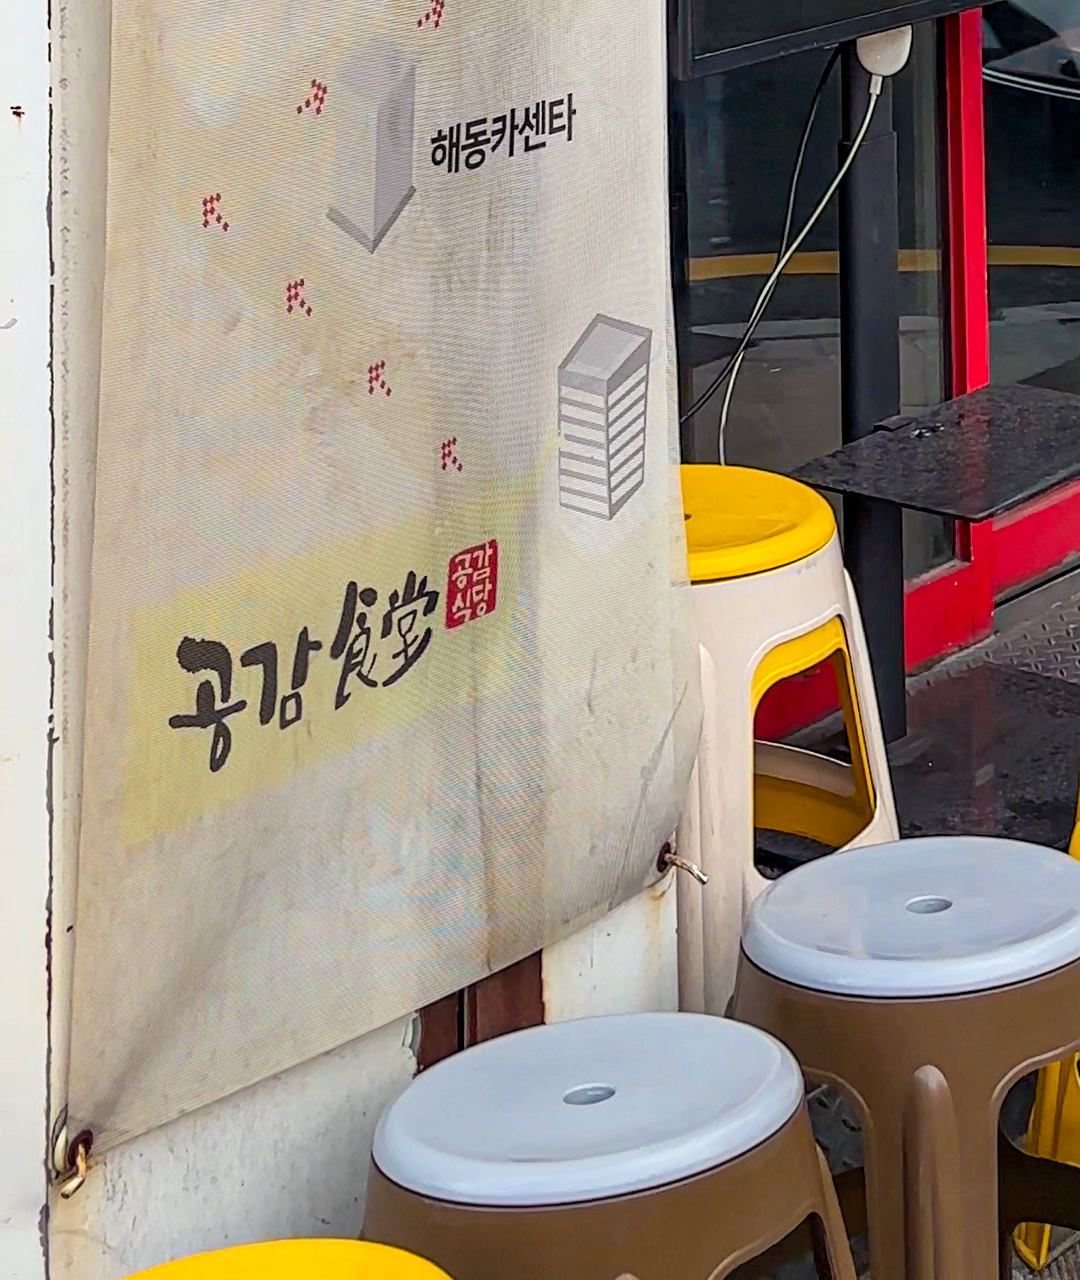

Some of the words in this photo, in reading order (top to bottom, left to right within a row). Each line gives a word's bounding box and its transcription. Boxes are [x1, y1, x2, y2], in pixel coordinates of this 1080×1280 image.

[430, 92, 577, 174] 해동카센타
[451, 541, 494, 590] 공감
[451, 578, 493, 623] 식당
[168, 571, 439, 772] 공감食堂
